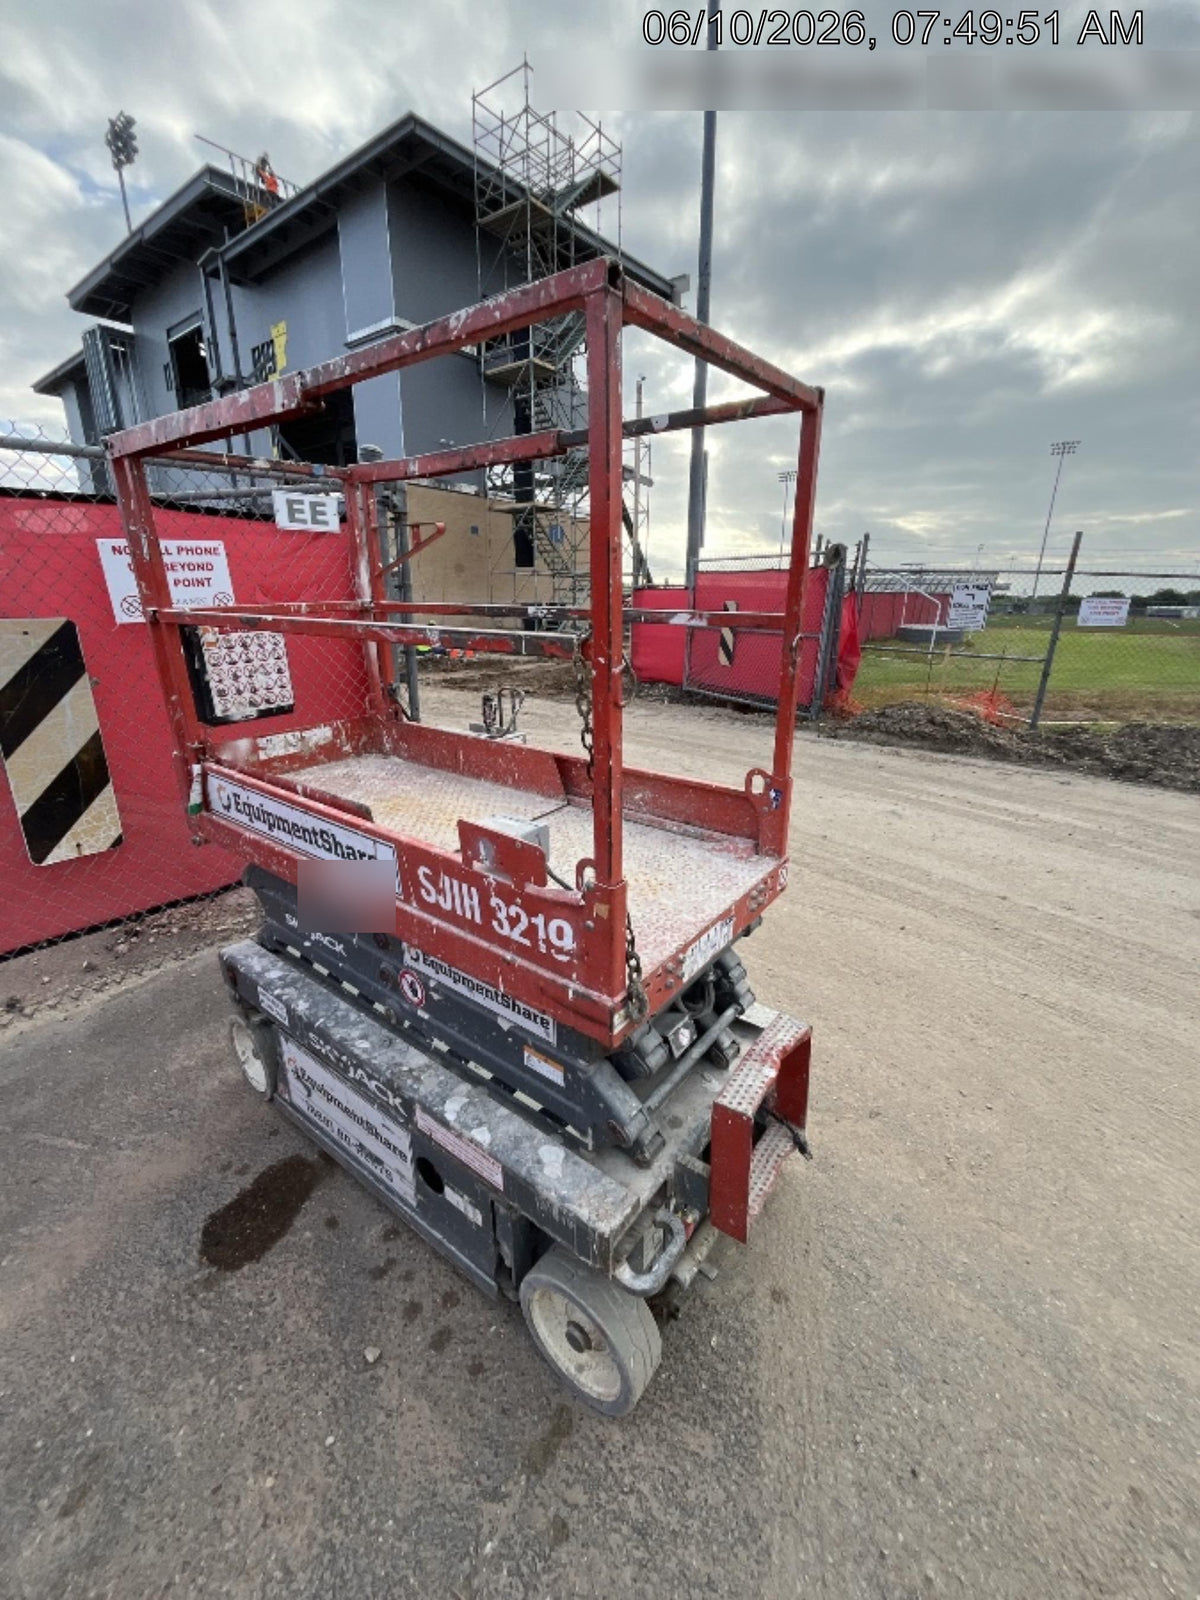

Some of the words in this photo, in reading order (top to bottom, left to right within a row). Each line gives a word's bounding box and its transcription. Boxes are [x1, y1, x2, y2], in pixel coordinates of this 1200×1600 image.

[286, 498, 330, 527] EE
[176, 545, 221, 556] PHONE
[173, 577, 212, 588] POINT
[490, 896, 575, 963] 3219
[422, 952, 550, 1030] EquipmentShare
